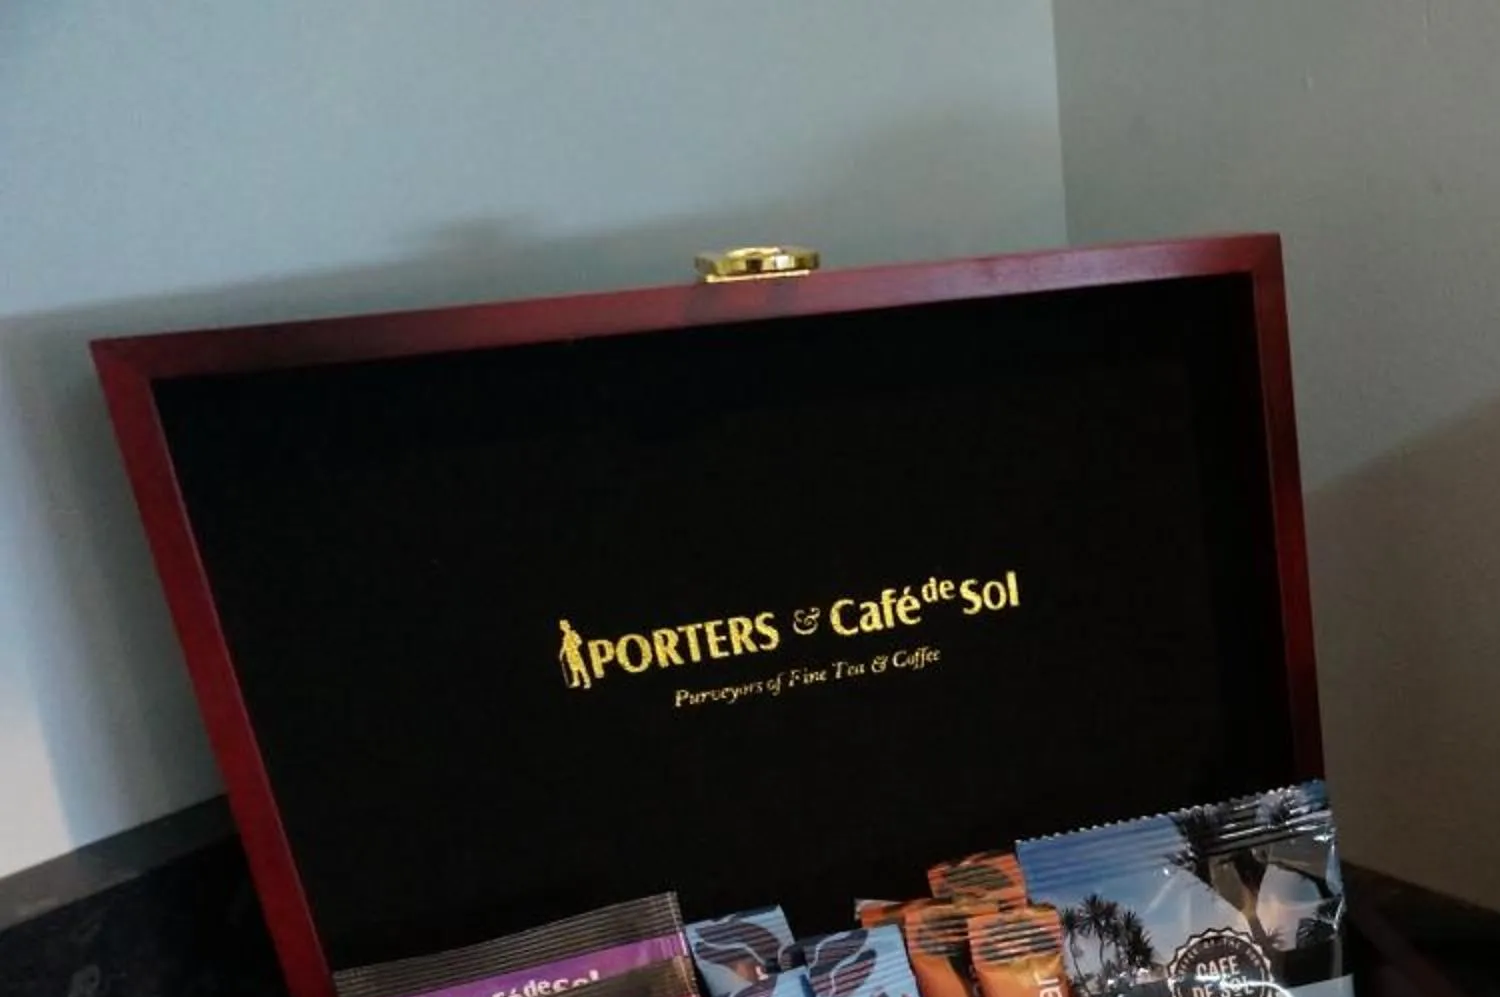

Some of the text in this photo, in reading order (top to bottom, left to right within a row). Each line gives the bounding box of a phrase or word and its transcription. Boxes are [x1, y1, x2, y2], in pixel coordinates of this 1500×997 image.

[588, 571, 1021, 678] PORTERS & Café de Sol
[674, 645, 942, 707] Purveyors of Fine Tea & Coffee
[1195, 955, 1241, 980] CAFE
